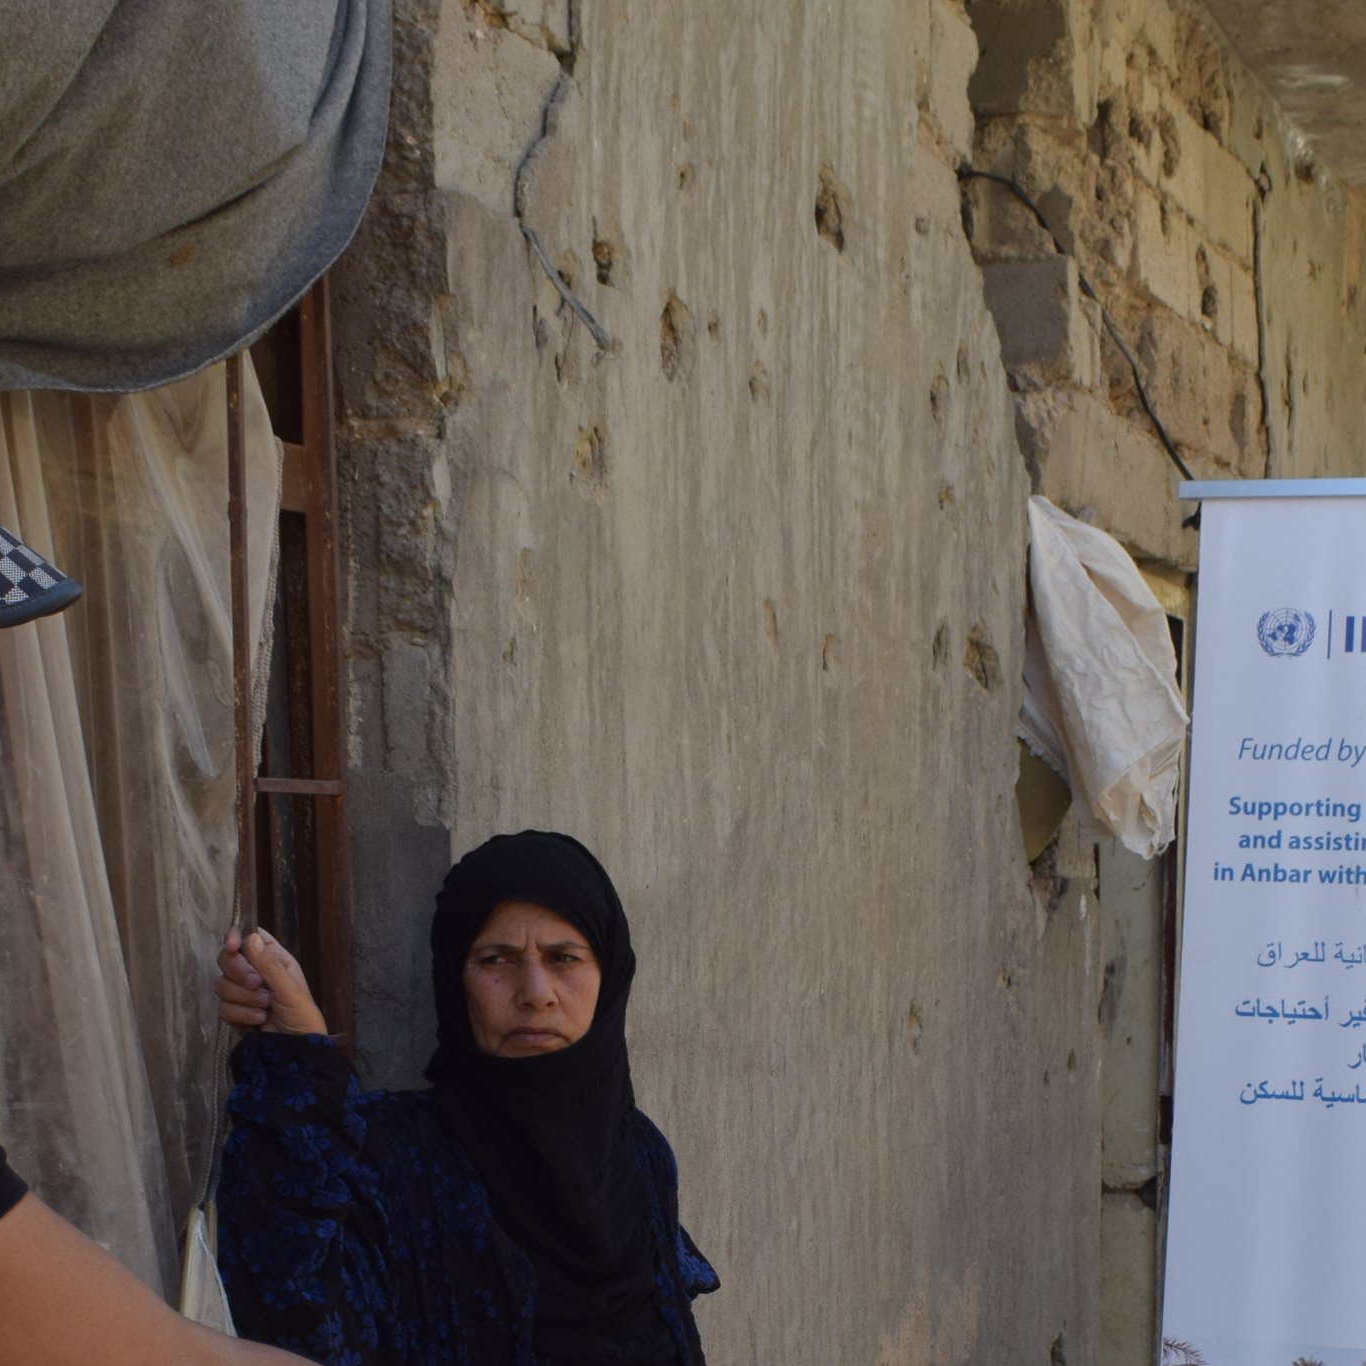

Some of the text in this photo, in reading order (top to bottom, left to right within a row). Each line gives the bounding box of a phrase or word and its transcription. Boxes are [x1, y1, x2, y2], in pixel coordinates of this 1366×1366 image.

[1238, 737, 1333, 761] Funded
[1337, 738, 1366, 768] by
[1228, 796, 1361, 822] Supporting
[1238, 830, 1282, 850] and
[1213, 862, 1235, 882] in
[1240, 863, 1312, 883] Anbar
[1256, 941, 1326, 968] للعراق
[1235, 994, 1329, 1025] أحتياجات
[1239, 1078, 1305, 1105] للسكن
